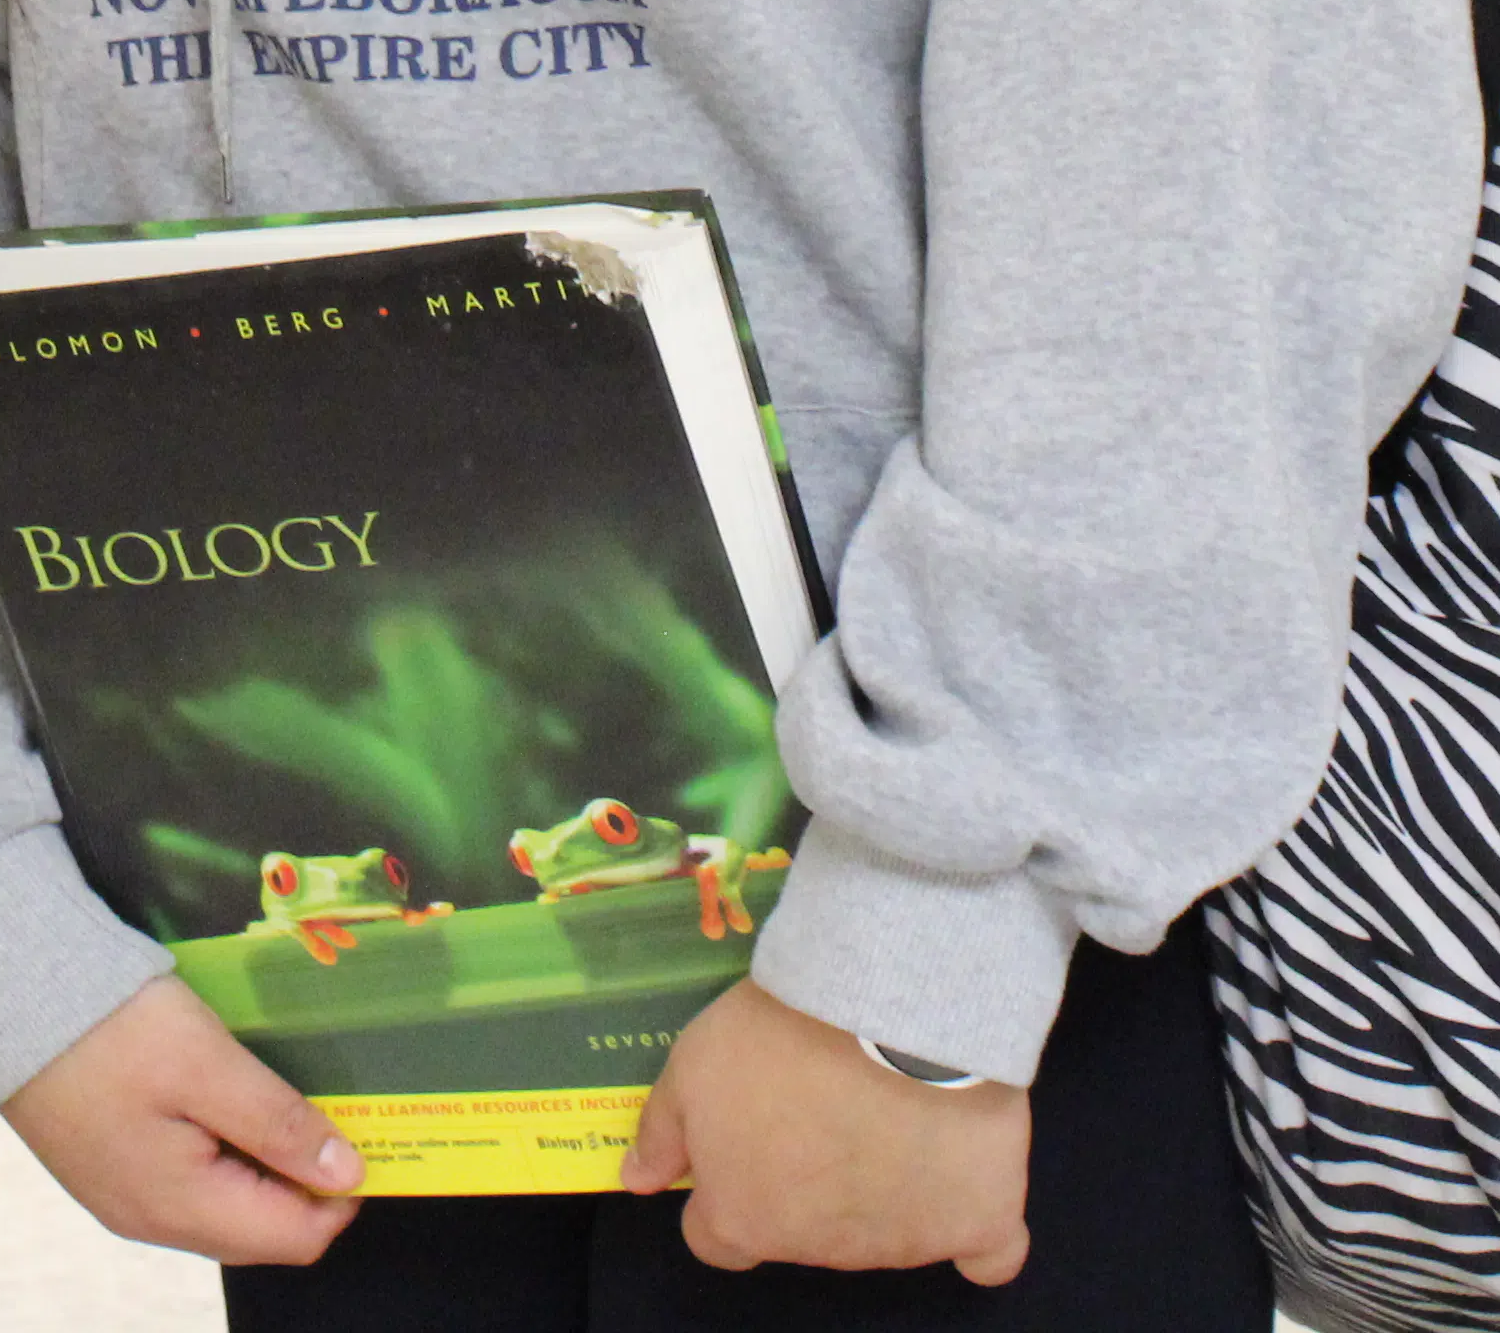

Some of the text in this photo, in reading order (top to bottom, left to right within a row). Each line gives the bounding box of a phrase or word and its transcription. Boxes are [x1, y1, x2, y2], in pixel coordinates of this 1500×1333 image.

[243, 23, 477, 83] EMPIRE
[498, 23, 653, 81] CITY
[237, 306, 346, 340] BERG
[333, 1104, 372, 1118] NEW
[378, 1101, 466, 1117] LEARNING
[472, 1098, 576, 1114] RESOURCES
